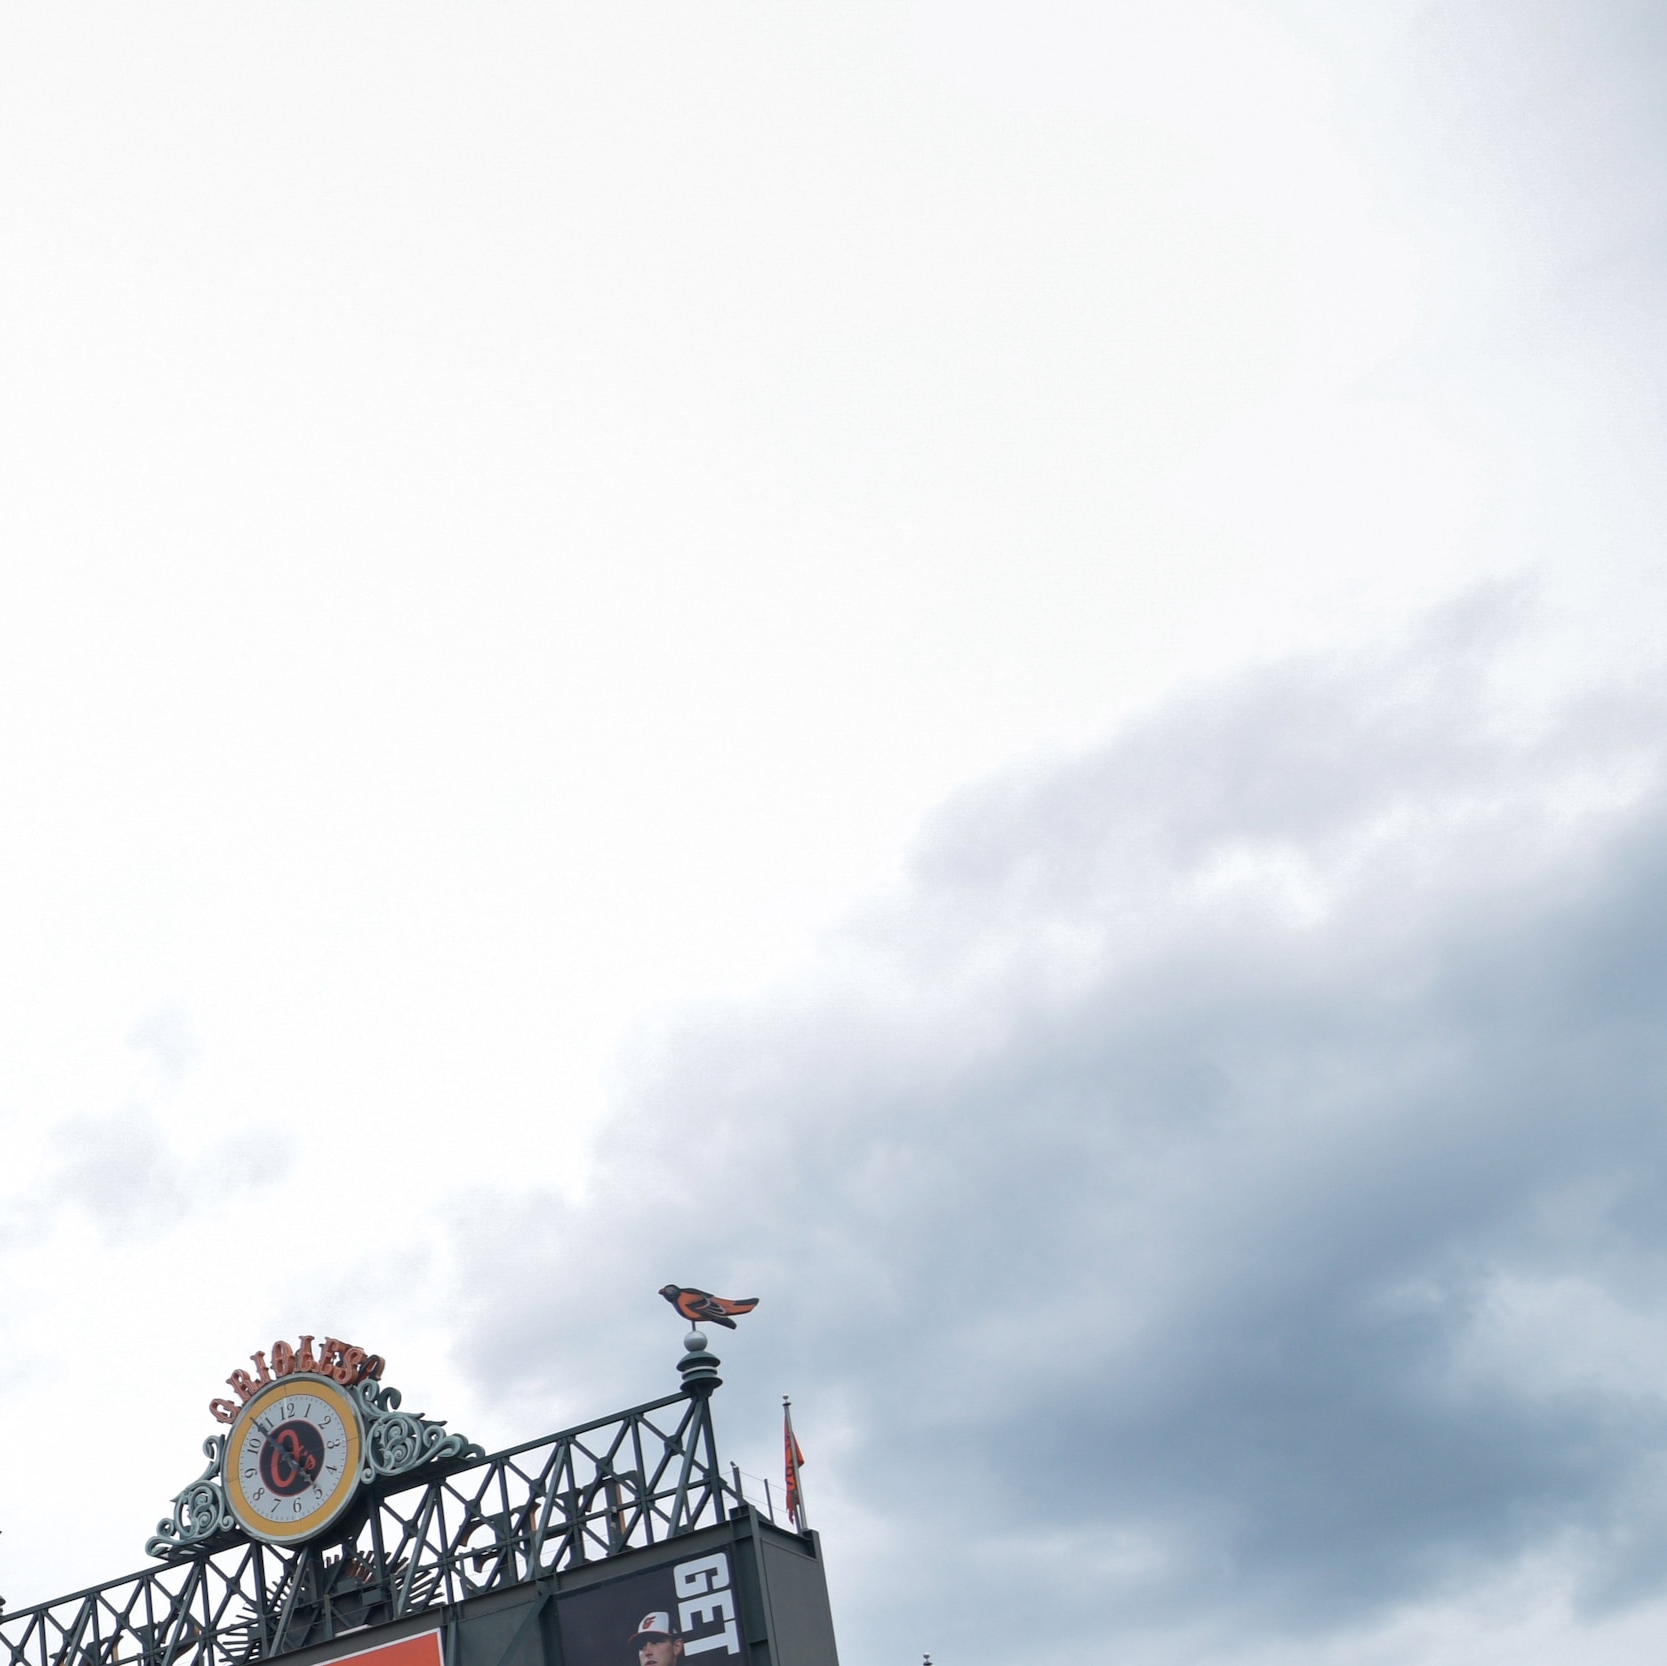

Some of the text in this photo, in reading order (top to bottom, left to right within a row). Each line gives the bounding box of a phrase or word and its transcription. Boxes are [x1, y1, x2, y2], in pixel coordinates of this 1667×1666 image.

[280, 1403, 295, 1420] 12
[303, 1403, 311, 1419] 1
[319, 1415, 332, 1431] 2
[246, 1439, 261, 1458] 10
[244, 1467, 256, 1479] 9
[325, 1464, 338, 1475] 4
[253, 1487, 266, 1501] 8
[314, 1485, 324, 1500] 5
[270, 1499, 282, 1513] 7
[292, 1497, 302, 1513] 6
[673, 1552, 740, 1656] GET
